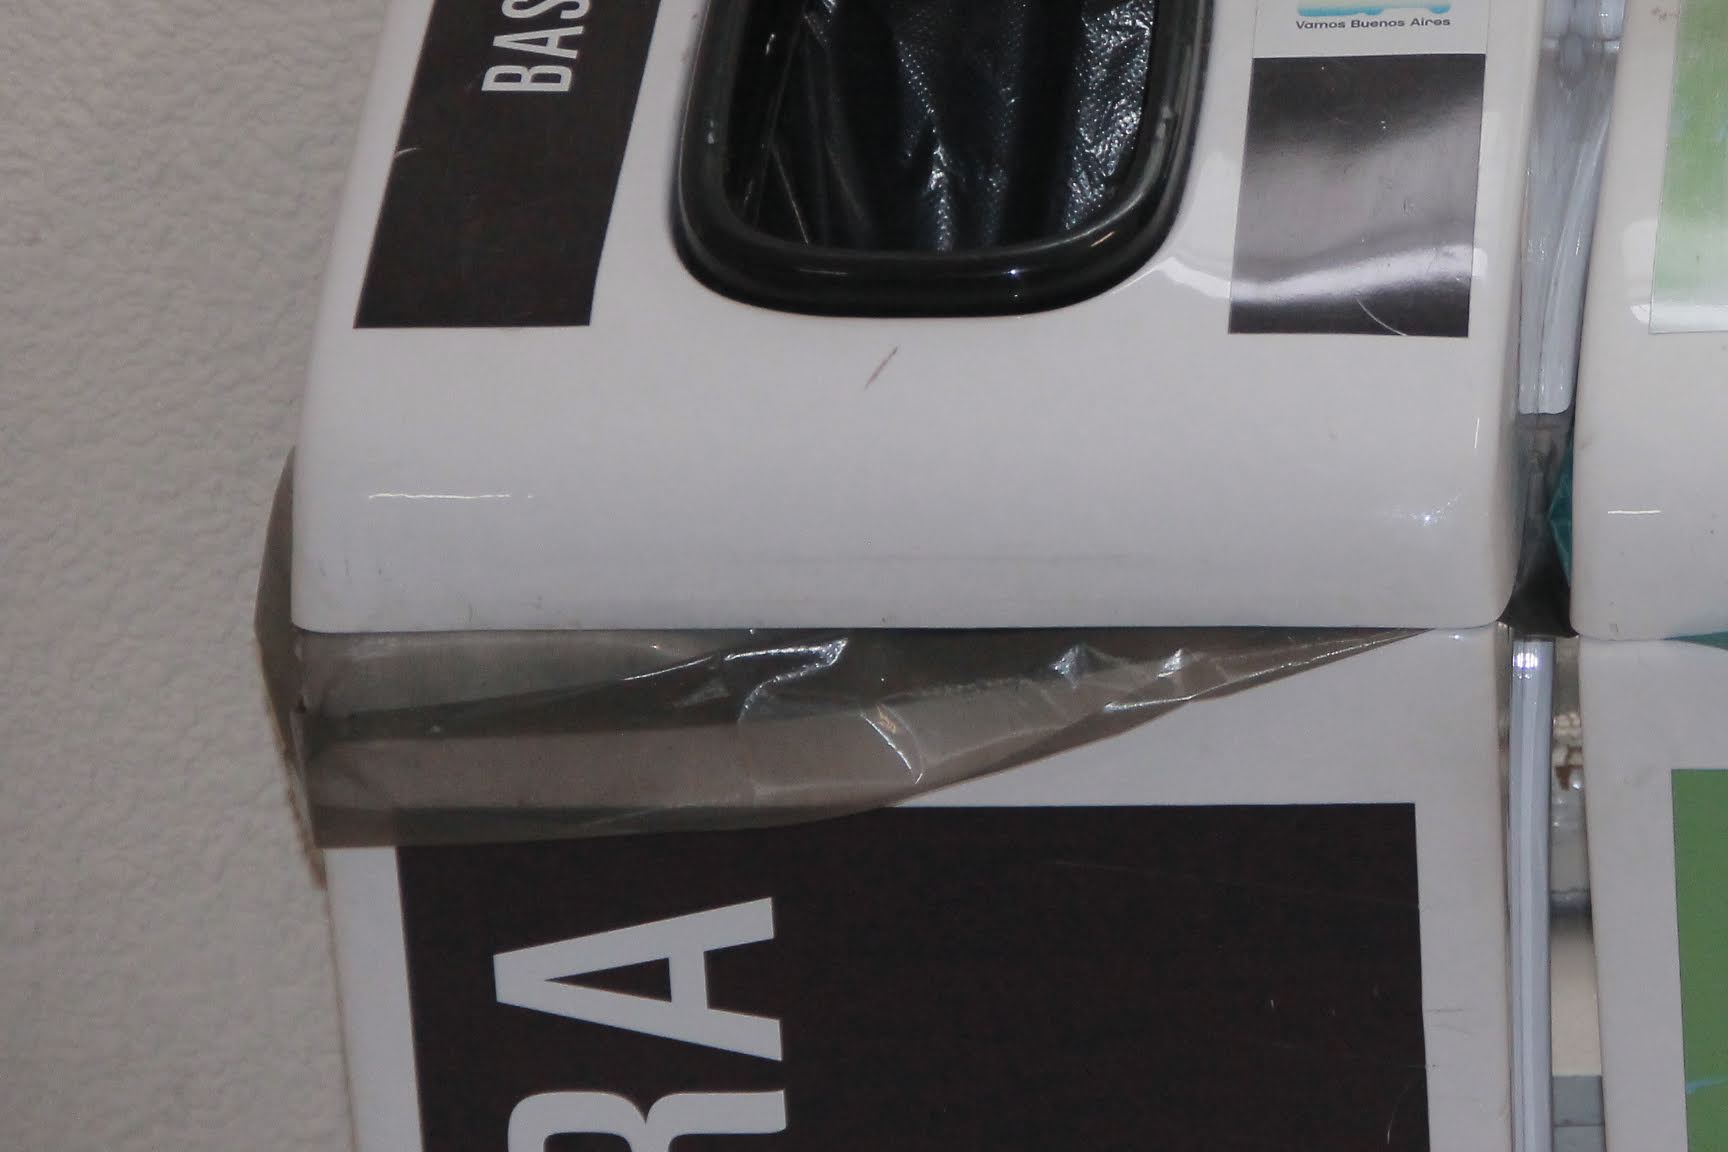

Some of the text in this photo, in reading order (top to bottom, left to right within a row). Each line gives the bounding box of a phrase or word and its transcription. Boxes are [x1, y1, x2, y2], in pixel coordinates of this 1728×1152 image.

[1296, 17, 1451, 29] Vamos Buenos Aires
